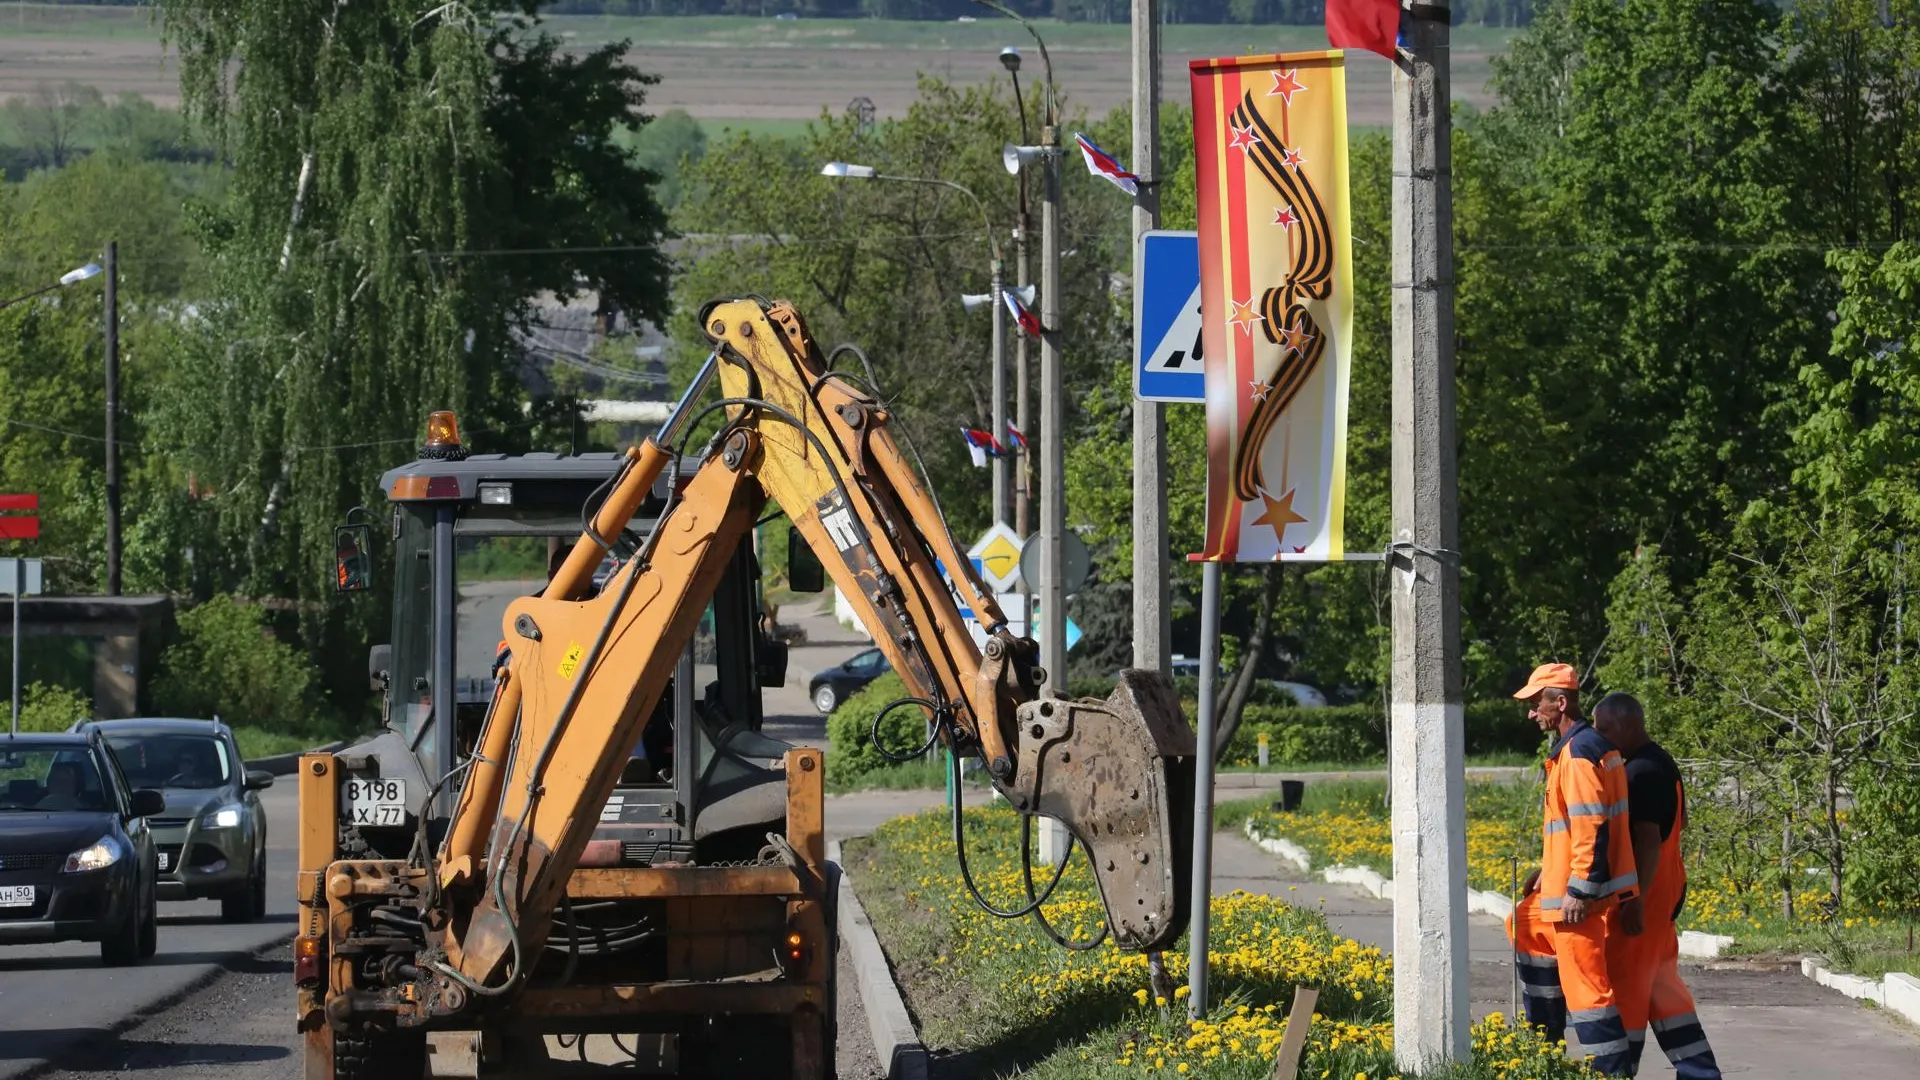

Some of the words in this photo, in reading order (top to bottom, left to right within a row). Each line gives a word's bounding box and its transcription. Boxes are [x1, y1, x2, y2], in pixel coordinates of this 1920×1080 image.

[348, 782, 398, 801] 8198
[381, 808, 400, 823] 77
[16, 886, 30, 897] 50
